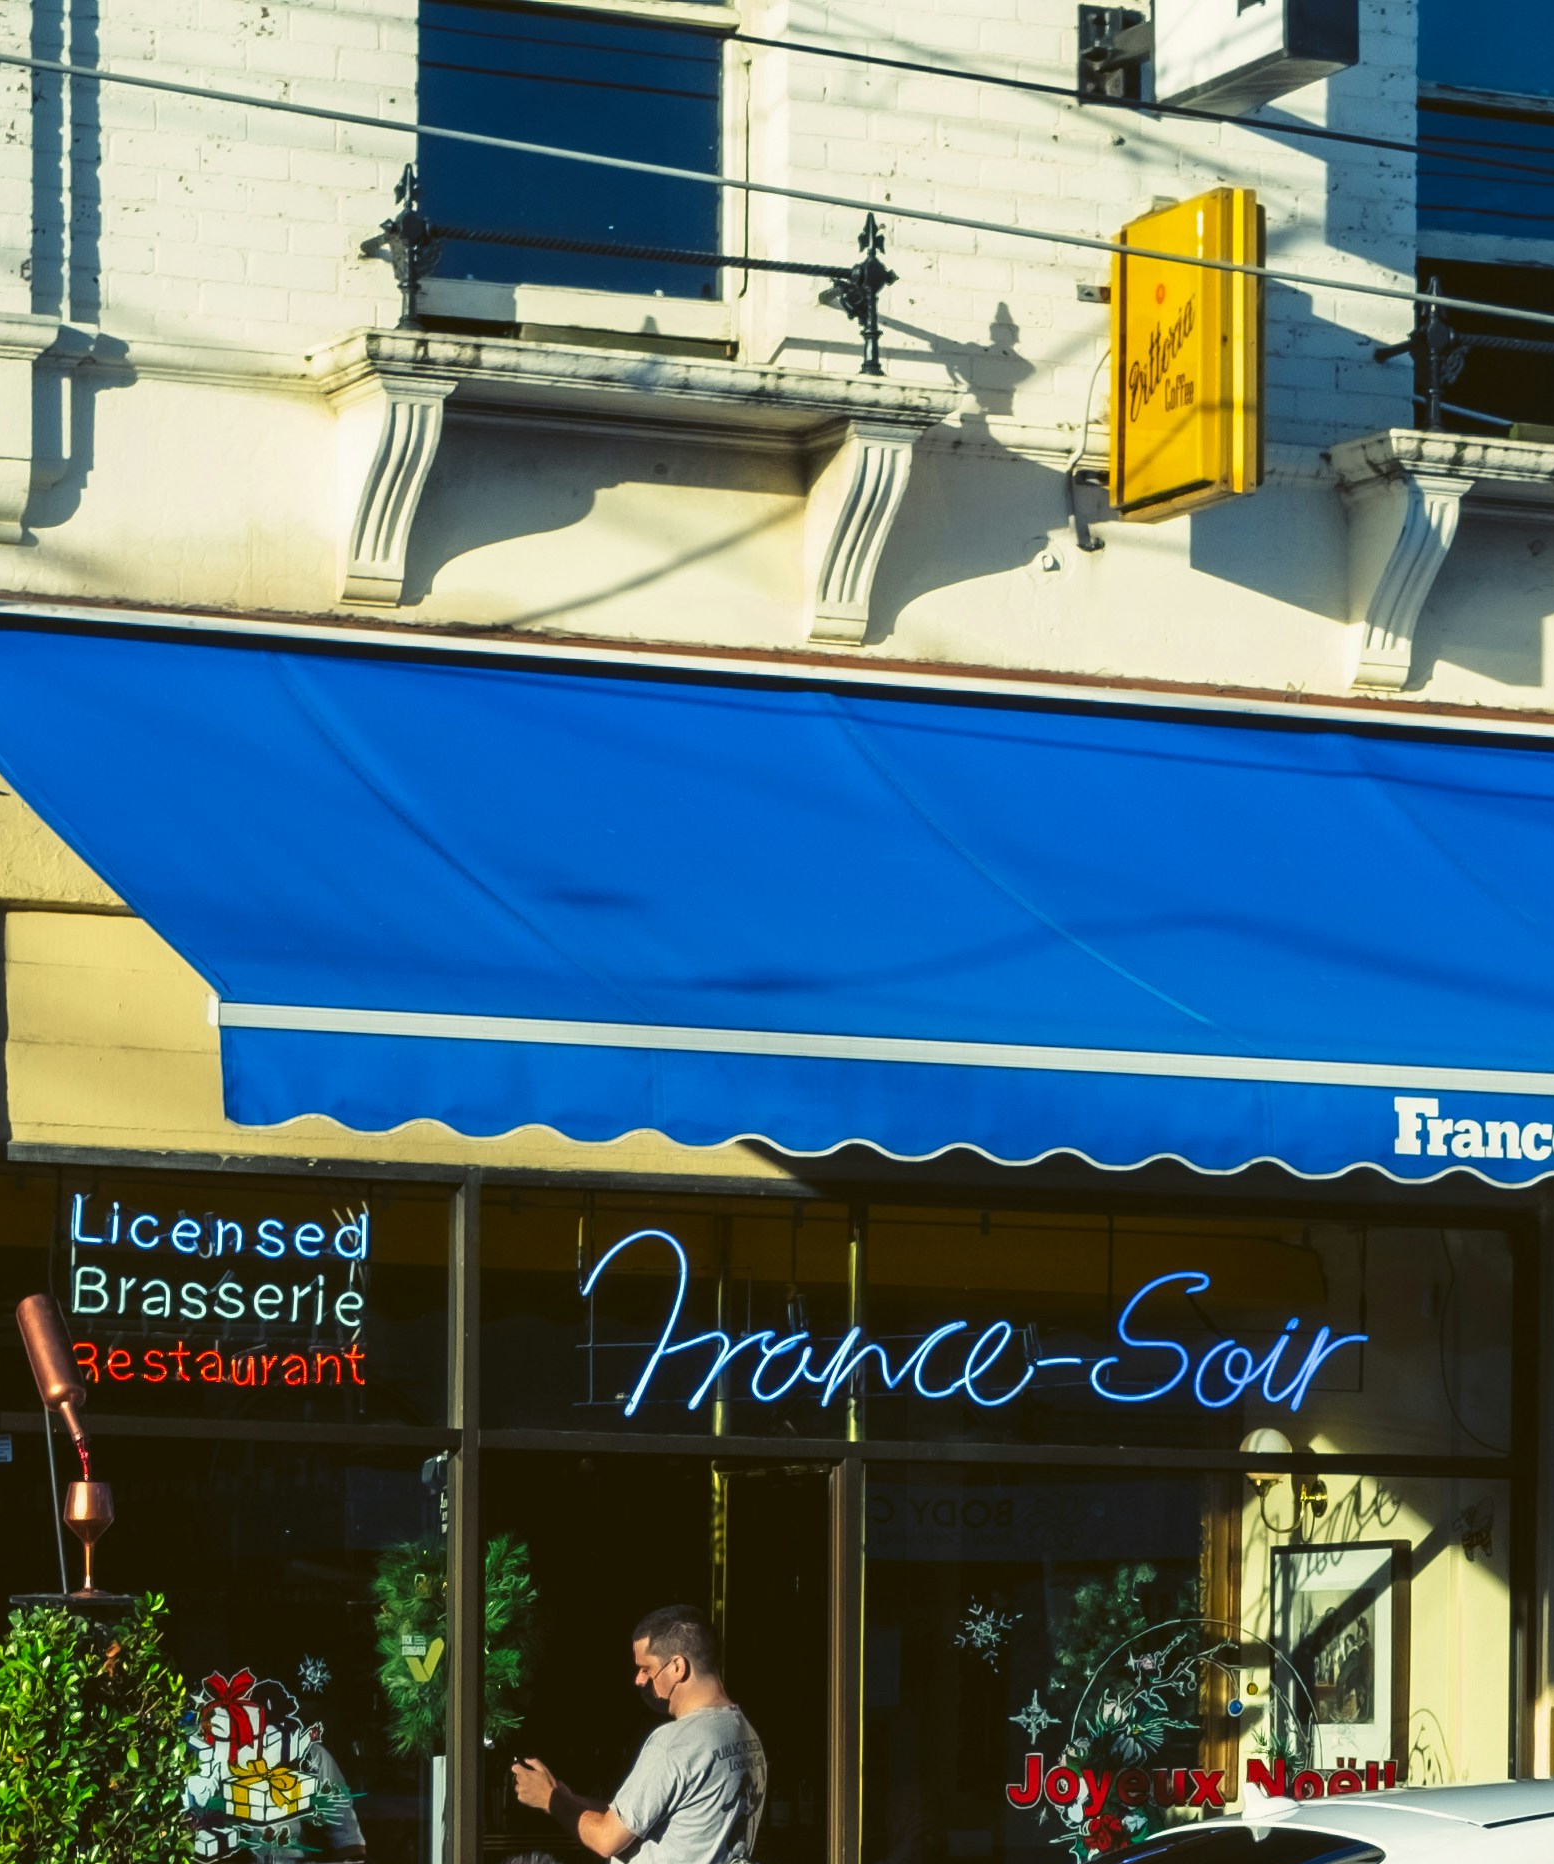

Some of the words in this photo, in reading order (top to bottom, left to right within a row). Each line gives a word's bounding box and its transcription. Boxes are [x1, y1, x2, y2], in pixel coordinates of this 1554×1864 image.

[1164, 373, 1194, 413] Coffee
[71, 1193, 369, 1260] Licensed
[71, 1265, 366, 1327] Brasserie
[580, 1229, 1370, 1418] France-Soir
[72, 1340, 366, 1386] Restaurant
[1005, 1752, 1227, 1818] Joyeux
